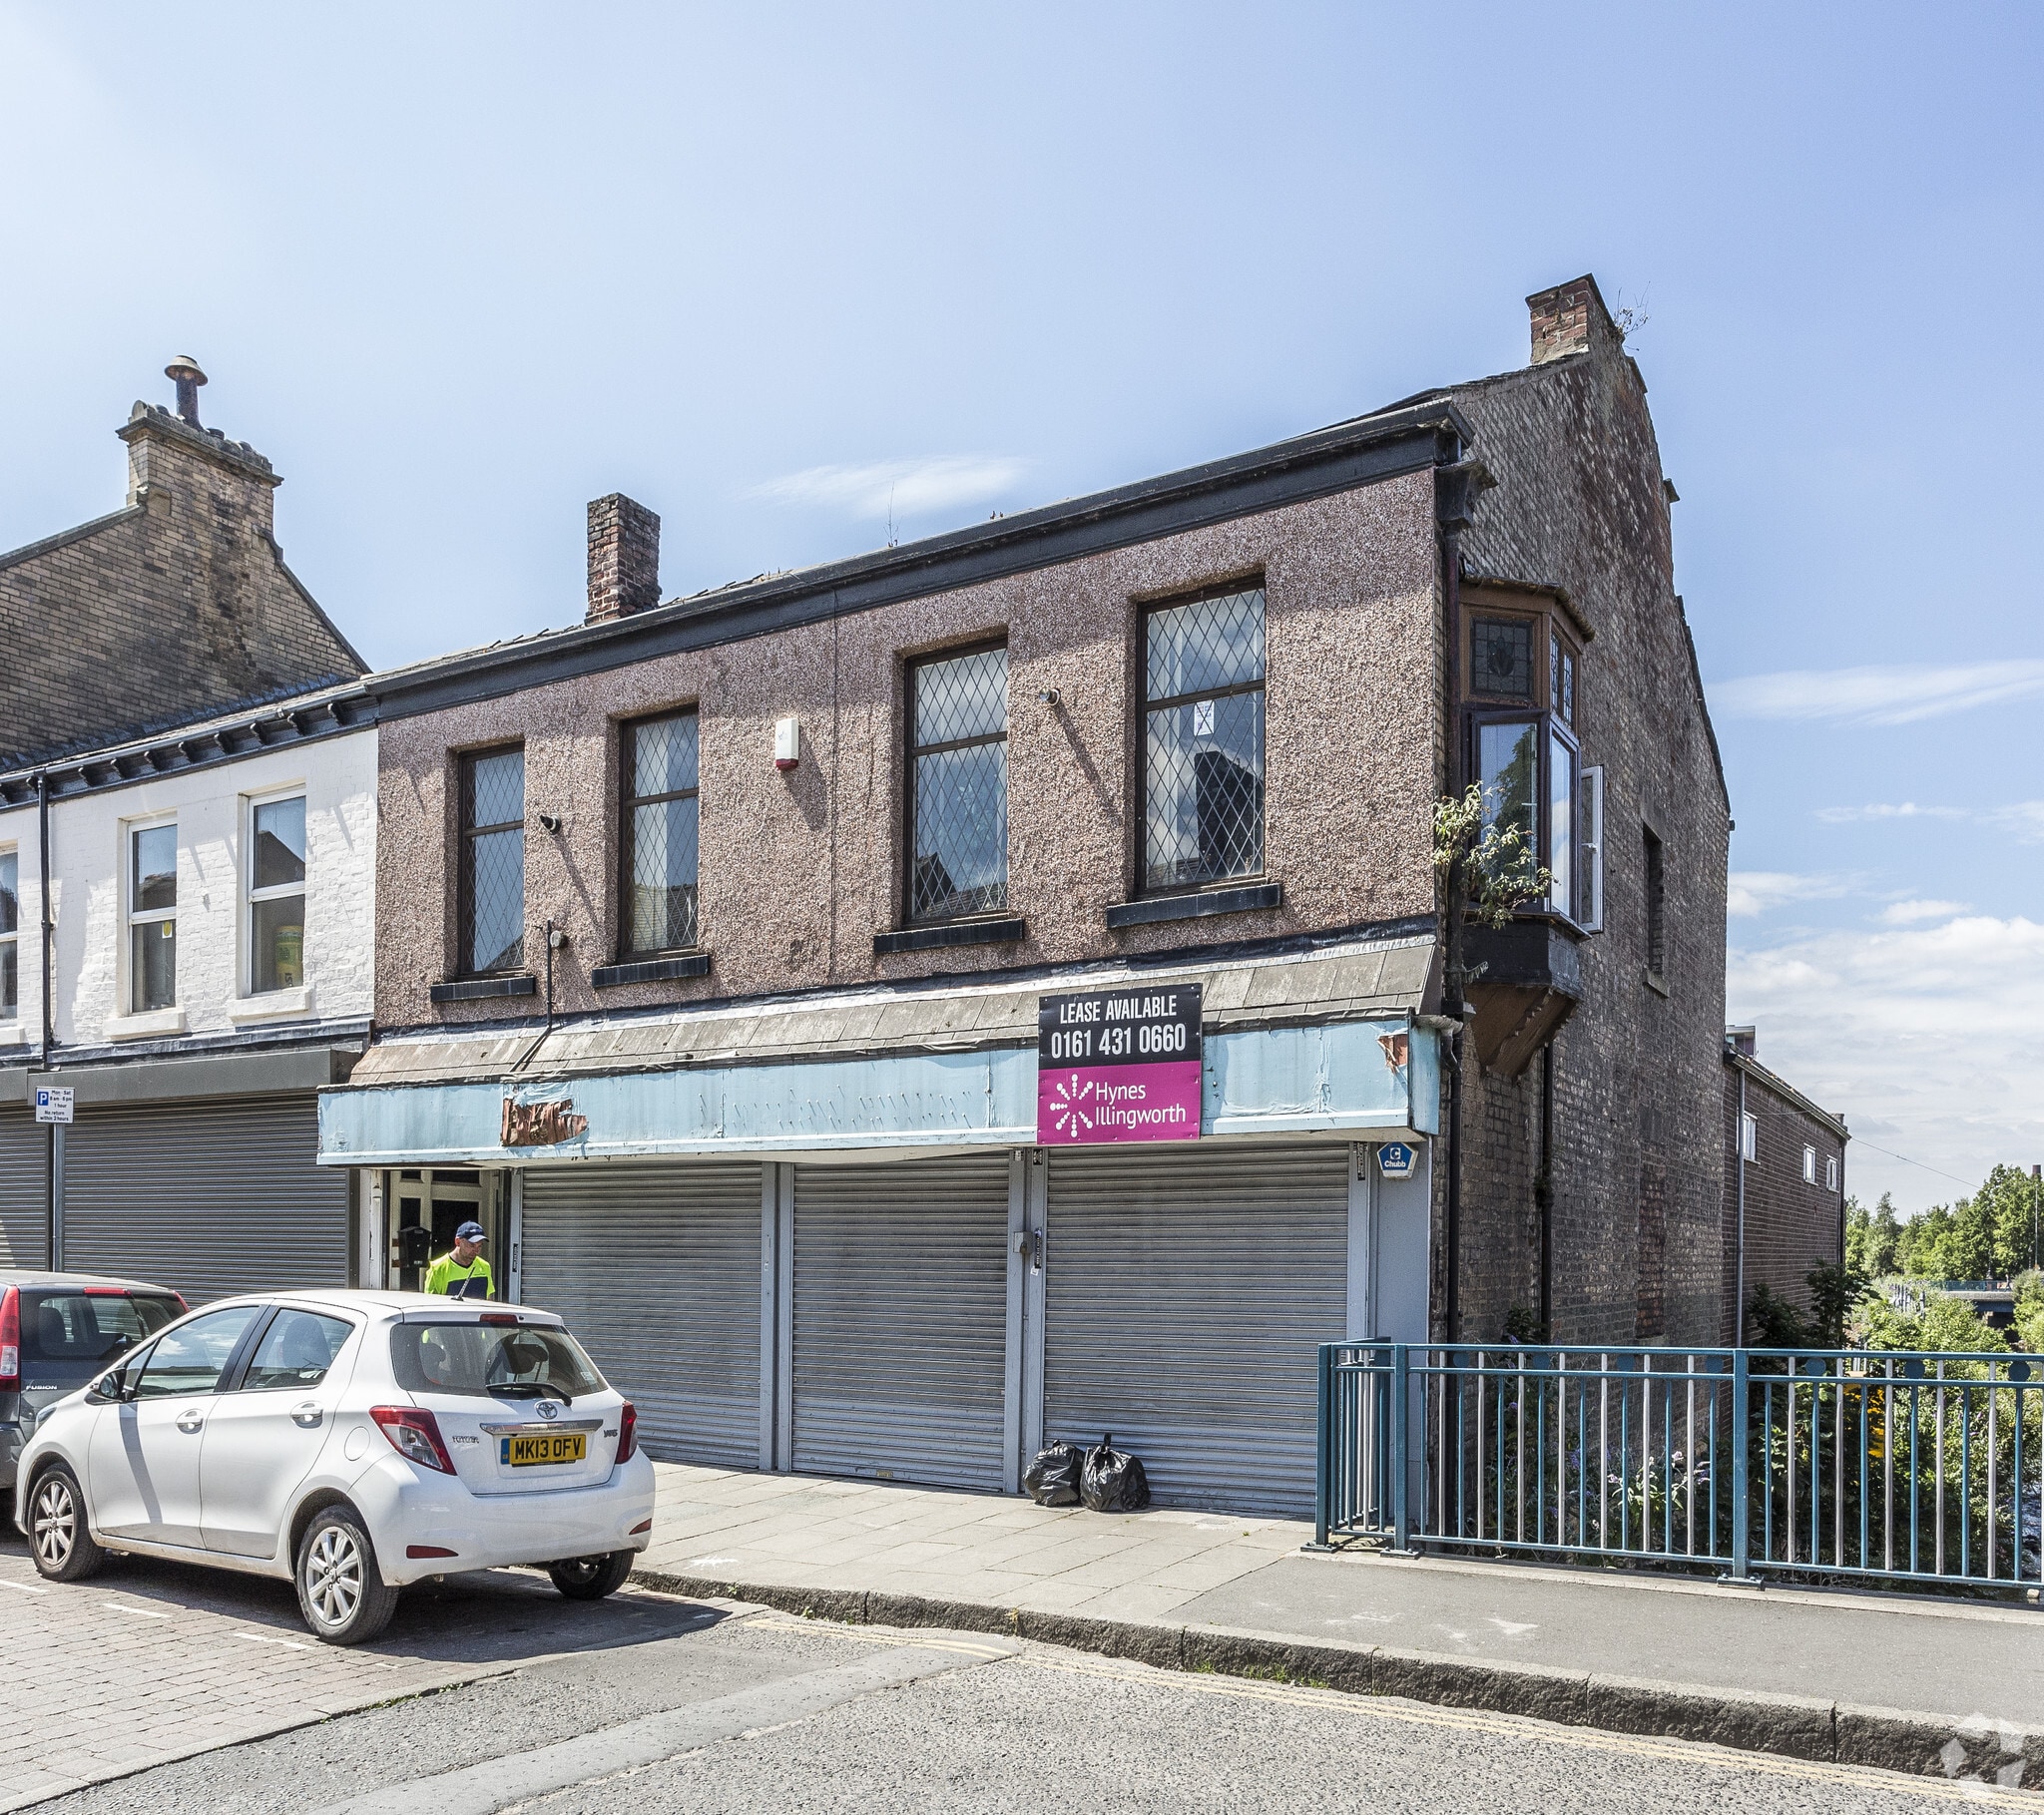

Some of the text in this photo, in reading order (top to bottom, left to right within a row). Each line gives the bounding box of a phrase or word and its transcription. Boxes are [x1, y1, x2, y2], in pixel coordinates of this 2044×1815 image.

[1060, 995, 1177, 1025] LEASE AVAILABLE
[1051, 1023, 1186, 1059] 0161 431 0660
[40, 1093, 47, 1105] P
[1096, 1082, 1146, 1105] Hynes
[1096, 1103, 1186, 1130] Illingworth
[515, 1438, 581, 1460] MK13 OFV
